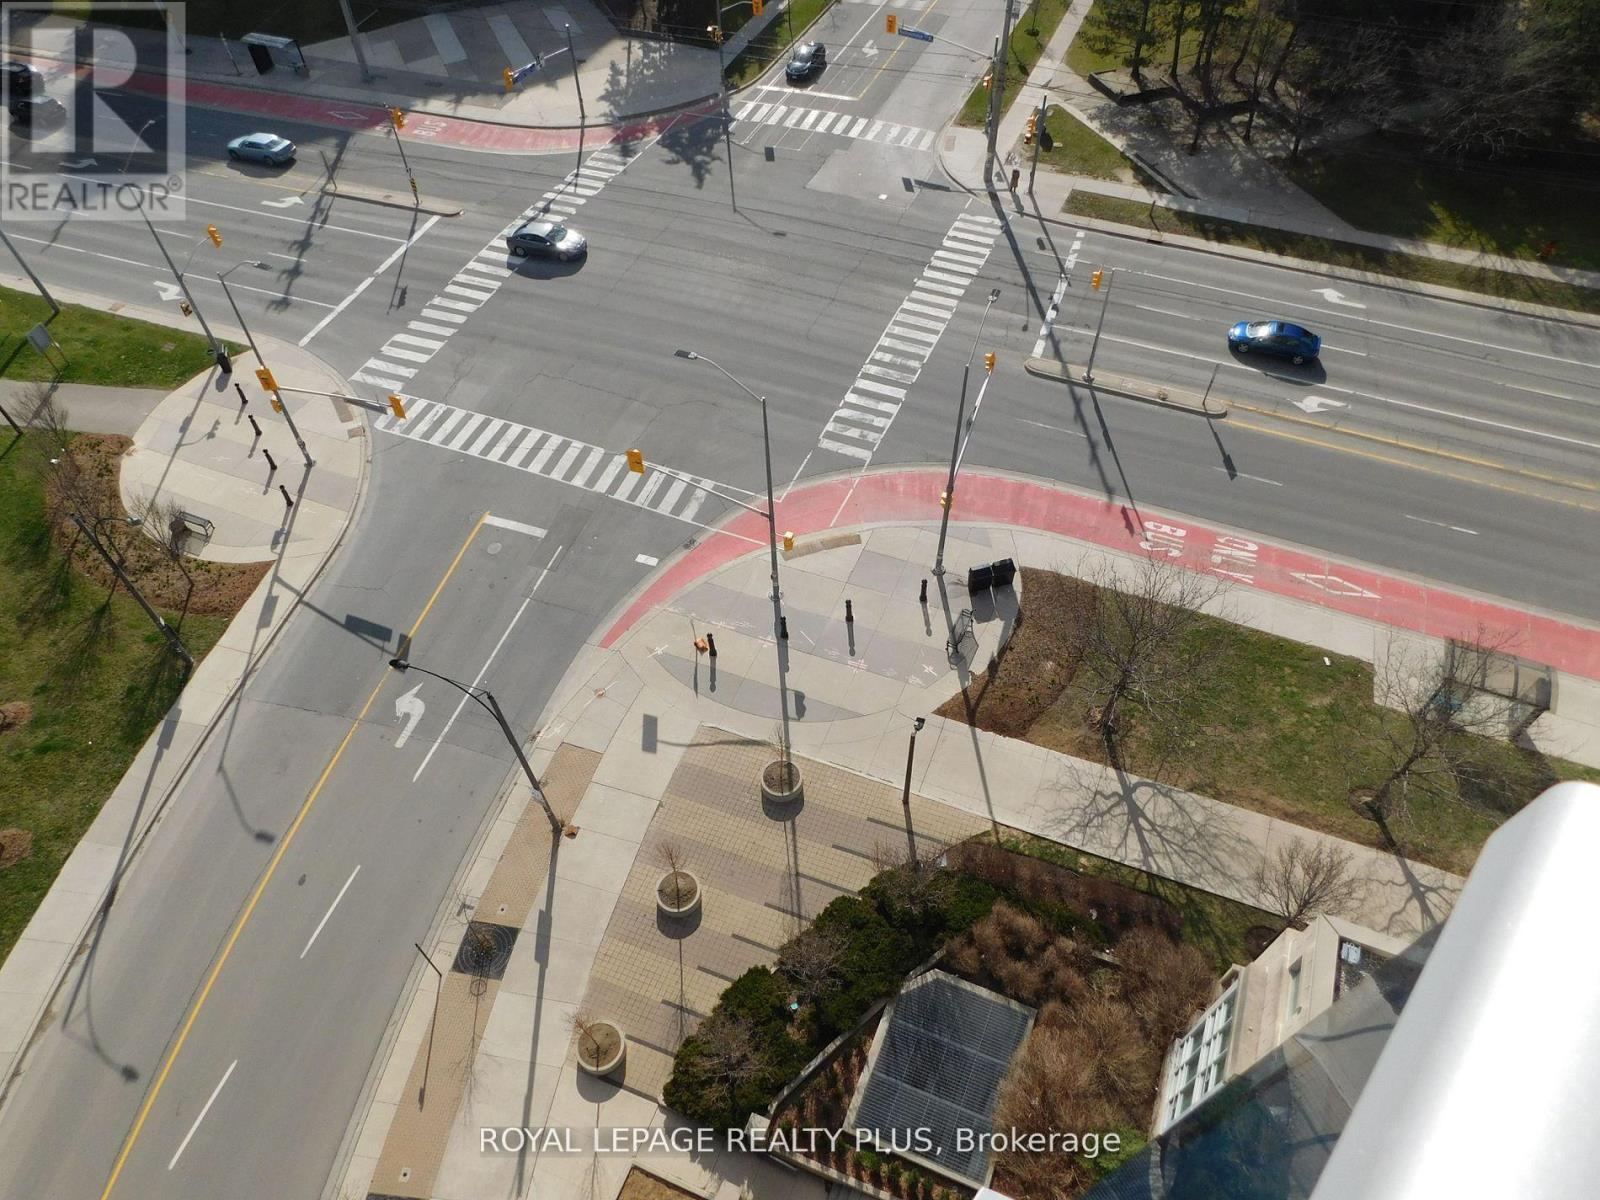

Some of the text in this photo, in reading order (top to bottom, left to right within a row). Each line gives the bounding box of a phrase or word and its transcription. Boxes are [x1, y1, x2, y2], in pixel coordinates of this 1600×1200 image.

[413, 121, 448, 137] BUS
[1138, 521, 1187, 558] BUS
[1209, 536, 1259, 584] ONLY
